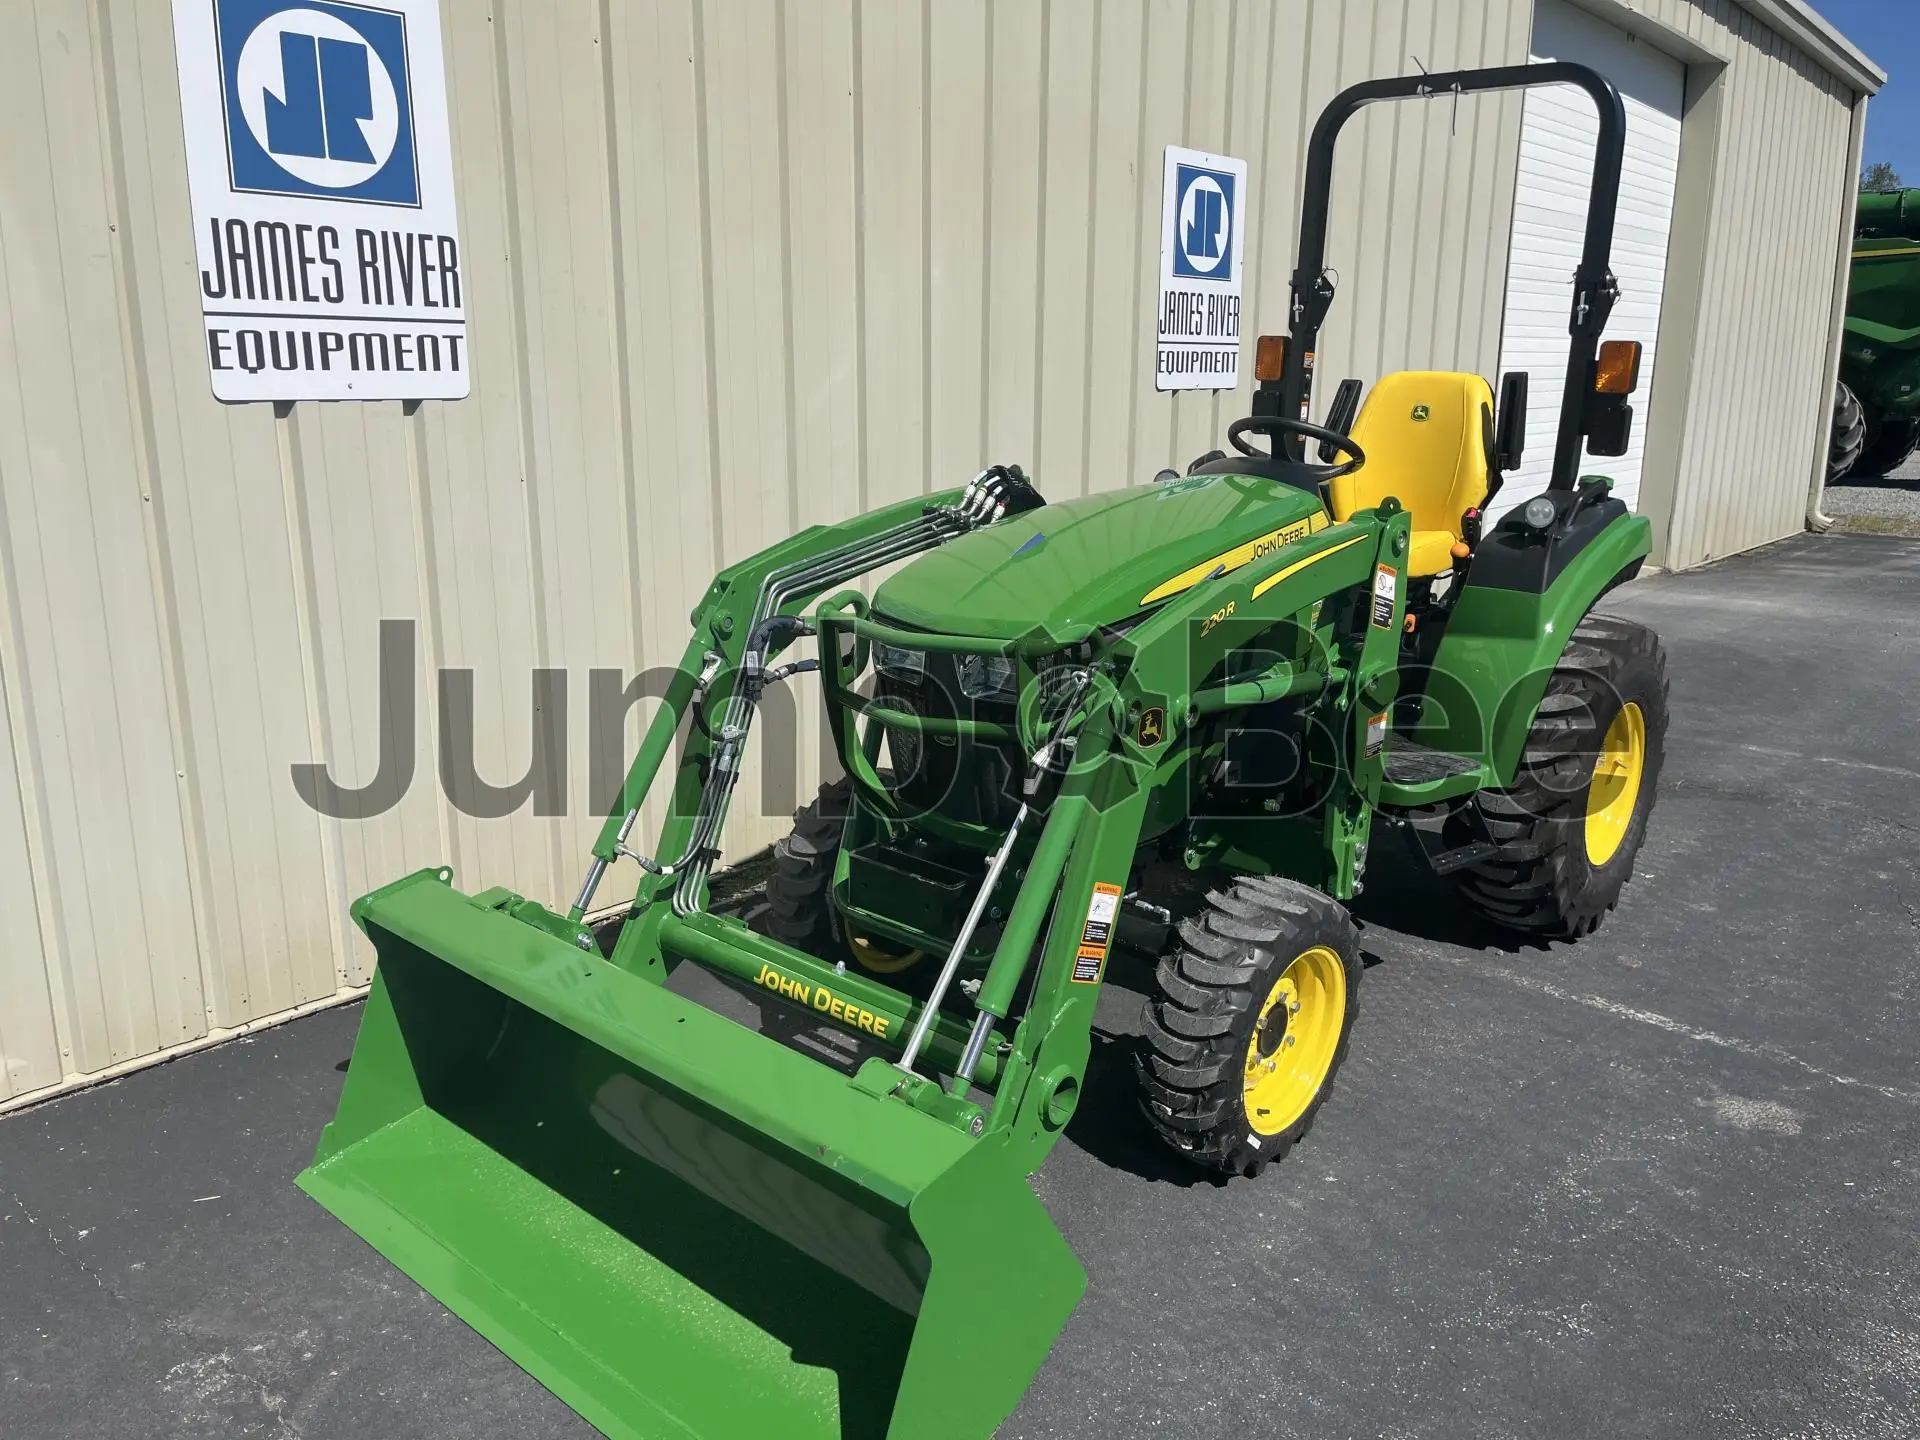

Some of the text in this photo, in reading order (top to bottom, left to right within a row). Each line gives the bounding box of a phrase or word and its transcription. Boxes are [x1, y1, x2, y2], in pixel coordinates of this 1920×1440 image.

[202, 217, 461, 308] JAMES RIVER
[1159, 291, 1240, 337] JAMES RIVER
[208, 328, 464, 374] EQUIPMENT
[1158, 350, 1239, 375] EQUIPMENT
[1251, 526, 1305, 561] JOHN DEERE
[753, 963, 890, 1040] JOHN DEERE
